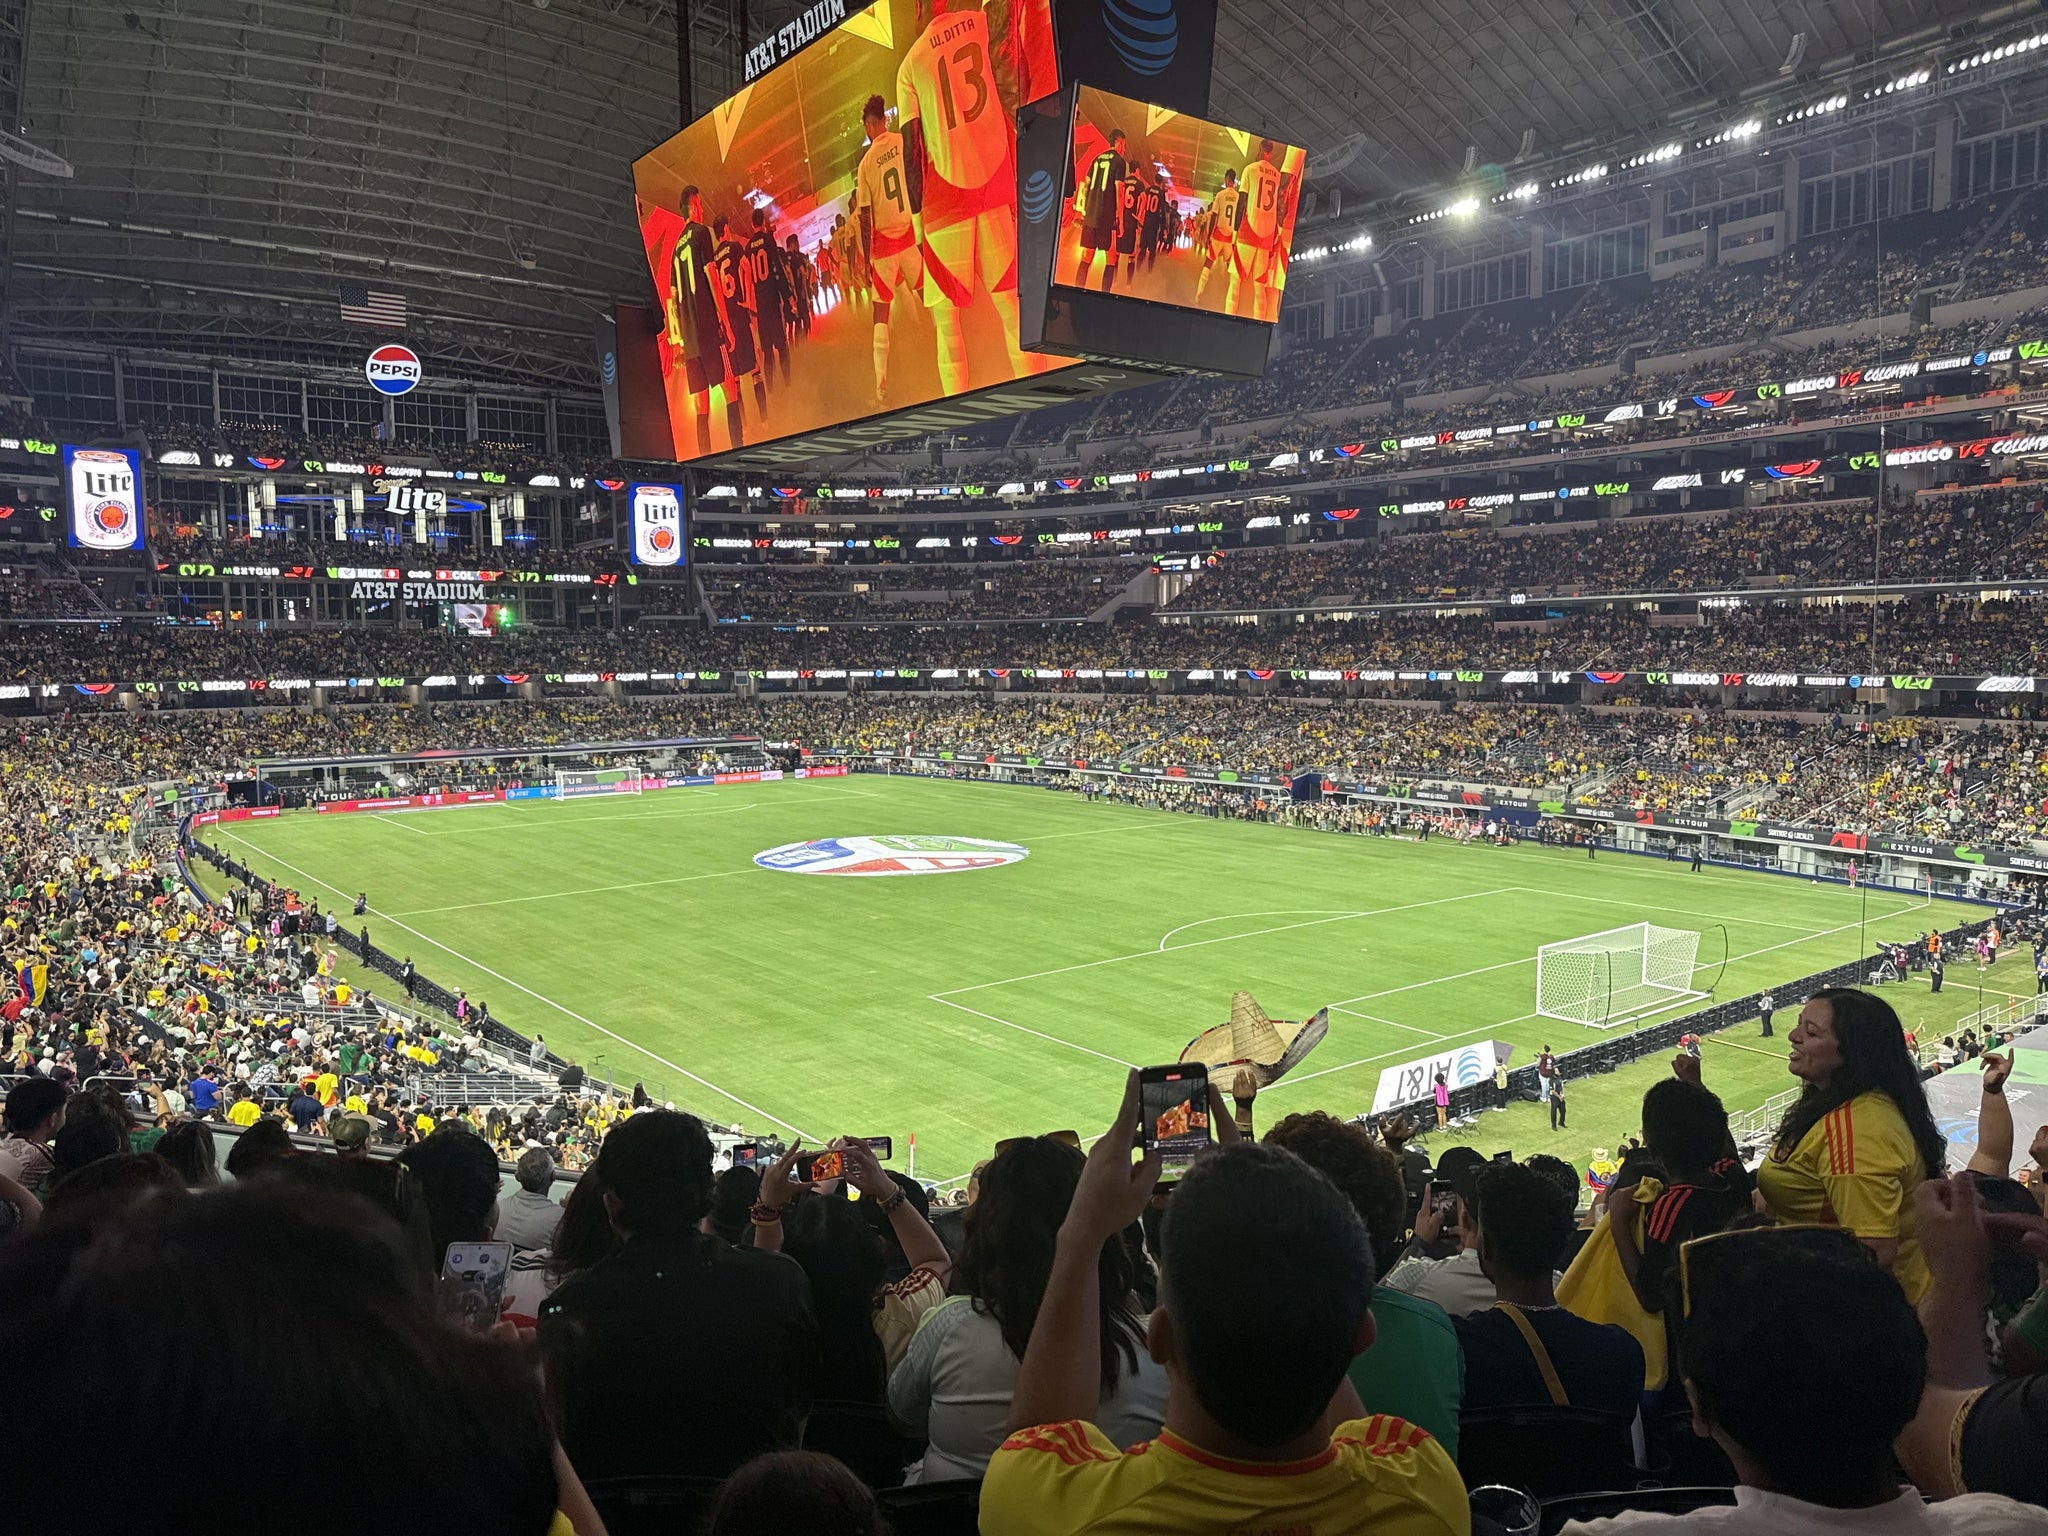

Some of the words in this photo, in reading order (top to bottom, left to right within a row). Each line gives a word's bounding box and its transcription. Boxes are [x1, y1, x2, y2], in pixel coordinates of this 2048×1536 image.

[744, 31, 777, 82] AT&T
[778, 0, 846, 57] STADIUM
[938, 42, 988, 130] 13
[1090, 161, 1111, 191] 17
[883, 167, 905, 213] 9
[1256, 176, 1277, 212] 13
[1124, 186, 1135, 209] 6
[1148, 195, 1159, 213] 10
[1225, 205, 1234, 227] 9
[751, 248, 769, 284] 10
[720, 257, 735, 298] 6
[370, 362, 418, 377] PEPSI
[1076, 352, 1223, 379] WINSTAR
[1839, 370, 1862, 388] VS
[1864, 363, 1919, 383] COLOMBIA
[1987, 349, 2013, 363] AT&T
[1658, 400, 1678, 415] VS
[1834, 418, 1844, 426] 73
[1846, 414, 1873, 425] LARRY
[1874, 411, 1901, 422] ALLEN
[738, 393, 1076, 463] WINSTAR
[1438, 432, 1454, 445] VS
[1455, 427, 1493, 441] COLOMBIA
[1537, 420, 1554, 429] AT&T
[1699, 434, 1726, 443] EMMITT
[1727, 432, 1750, 441] SMITH
[1309, 450, 1324, 463] VS
[1959, 443, 1989, 459] VS
[214, 454, 234, 468] VS
[367, 465, 383, 476] VS
[1137, 470, 1151, 482] VS
[1721, 468, 1746, 484] VS
[83, 470, 132, 498] Lite
[570, 477, 586, 489] VS
[1034, 480, 1047, 492] VS
[748, 487, 762, 497] VS
[867, 488, 881, 498] VS
[1449, 498, 1467, 510] VS
[1469, 493, 1514, 508] COLOMBIA
[1570, 486, 1590, 498] AT&T
[385, 485, 445, 515] Lite
[643, 502, 677, 525] Lite
[1293, 512, 1310, 525] VS
[1093, 529, 1108, 540] VS
[753, 538, 771, 549] VS
[961, 537, 978, 547] VS
[358, 567, 384, 579] MEX
[452, 570, 475, 581] COL
[350, 582, 399, 599] AT&T
[402, 583, 485, 600] STADIUM
[468, 674, 486, 686] VS
[600, 673, 615, 682] VS
[800, 670, 814, 679] VS
[967, 668, 980, 678] VS
[1062, 669, 1075, 678] VS
[1223, 670, 1238, 680] VS
[1343, 670, 1358, 680] VS
[1552, 671, 1571, 684] VS
[1723, 673, 1743, 686] VS
[1747, 674, 1798, 686] COLOMBIA
[1862, 676, 1885, 687] AT&T
[42, 684, 60, 697] VS
[249, 681, 266, 690] VS
[812, 768, 840, 776] STRAUSS
[1667, 817, 1709, 828] MEXTOUR
[1880, 841, 1934, 855] MEXTOUR
[1389, 1057, 1453, 1107] AT&T
